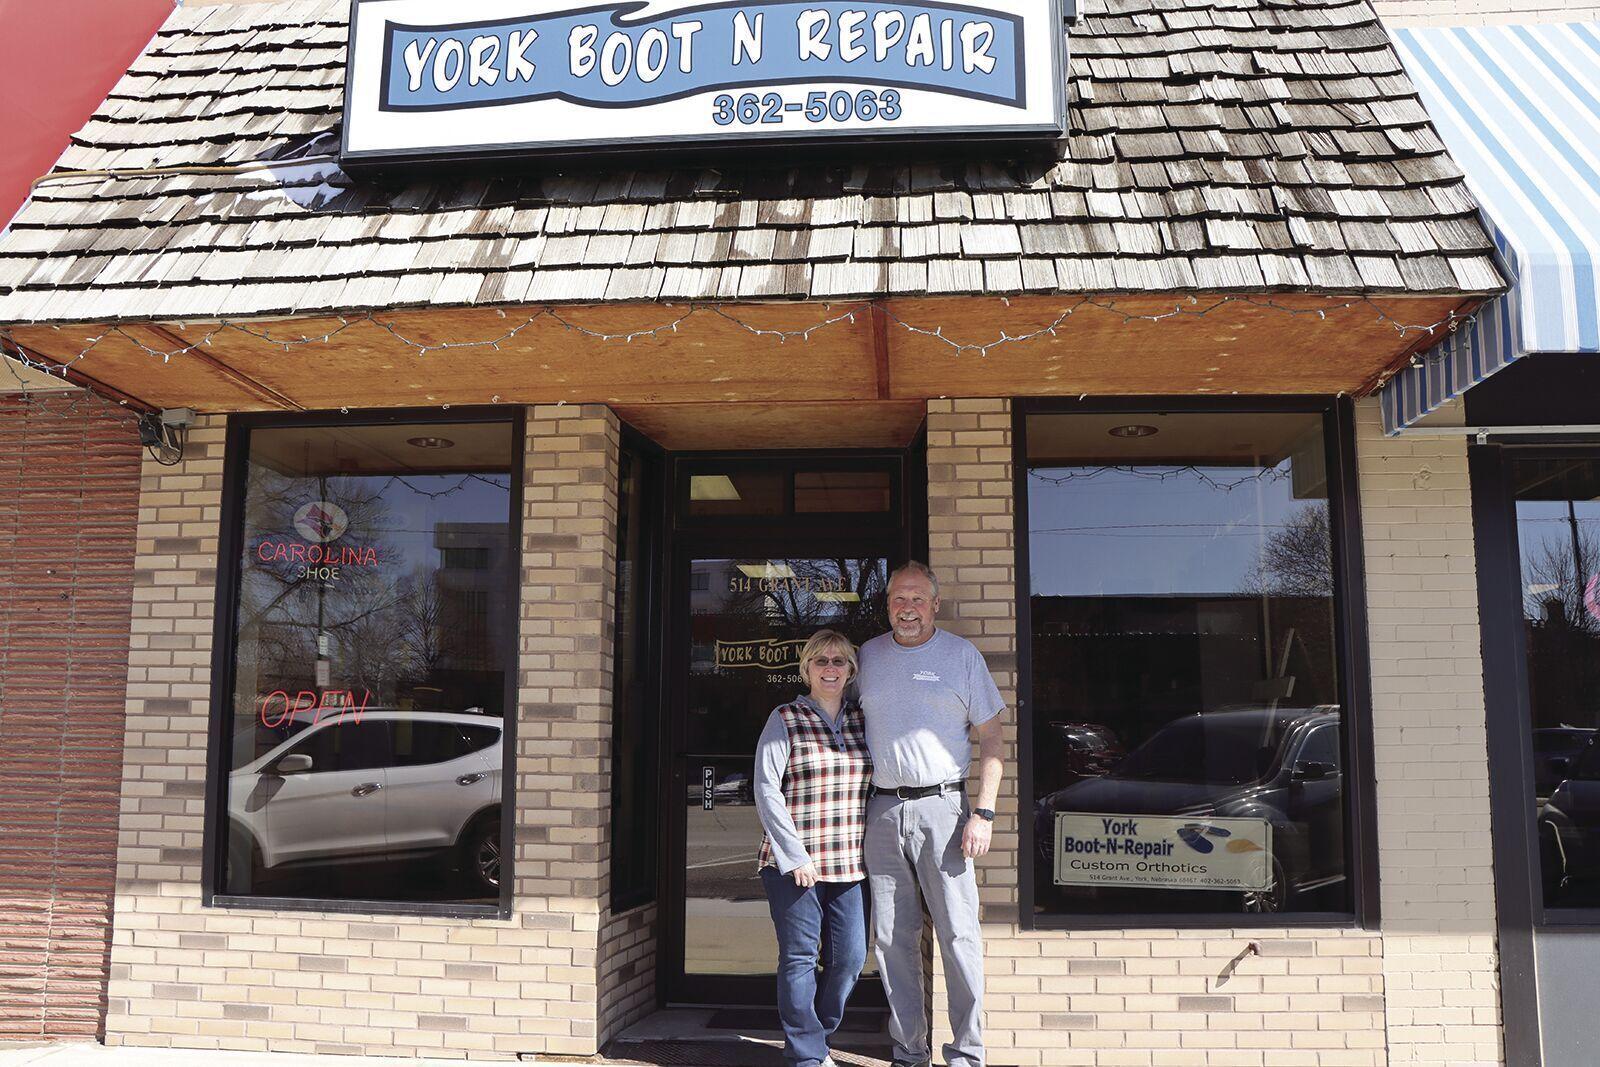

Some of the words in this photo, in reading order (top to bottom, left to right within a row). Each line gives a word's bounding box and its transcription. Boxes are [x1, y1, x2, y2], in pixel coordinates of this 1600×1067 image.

[402, 28, 540, 92] YORK
[568, 20, 703, 88] BOOT
[730, 10, 764, 67] N
[796, 7, 998, 75] REPAIR
[711, 88, 902, 126] 362-5063
[258, 541, 379, 566] CAROLINA
[296, 565, 341, 581] SHOE
[730, 577, 751, 593] 514
[758, 576, 813, 593] GRANT
[819, 576, 847, 592] AVE
[720, 645, 753, 662] YORK
[759, 645, 789, 664] BOOT
[767, 674, 804, 683] 362-506
[261, 689, 370, 729] OPEN
[705, 769, 713, 809] PUSH
[1102, 818, 1138, 836] York
[1064, 837, 1175, 859] Boot-N-Repair
[1070, 859, 1130, 872] Custom
[1135, 861, 1208, 874] Orthotics
